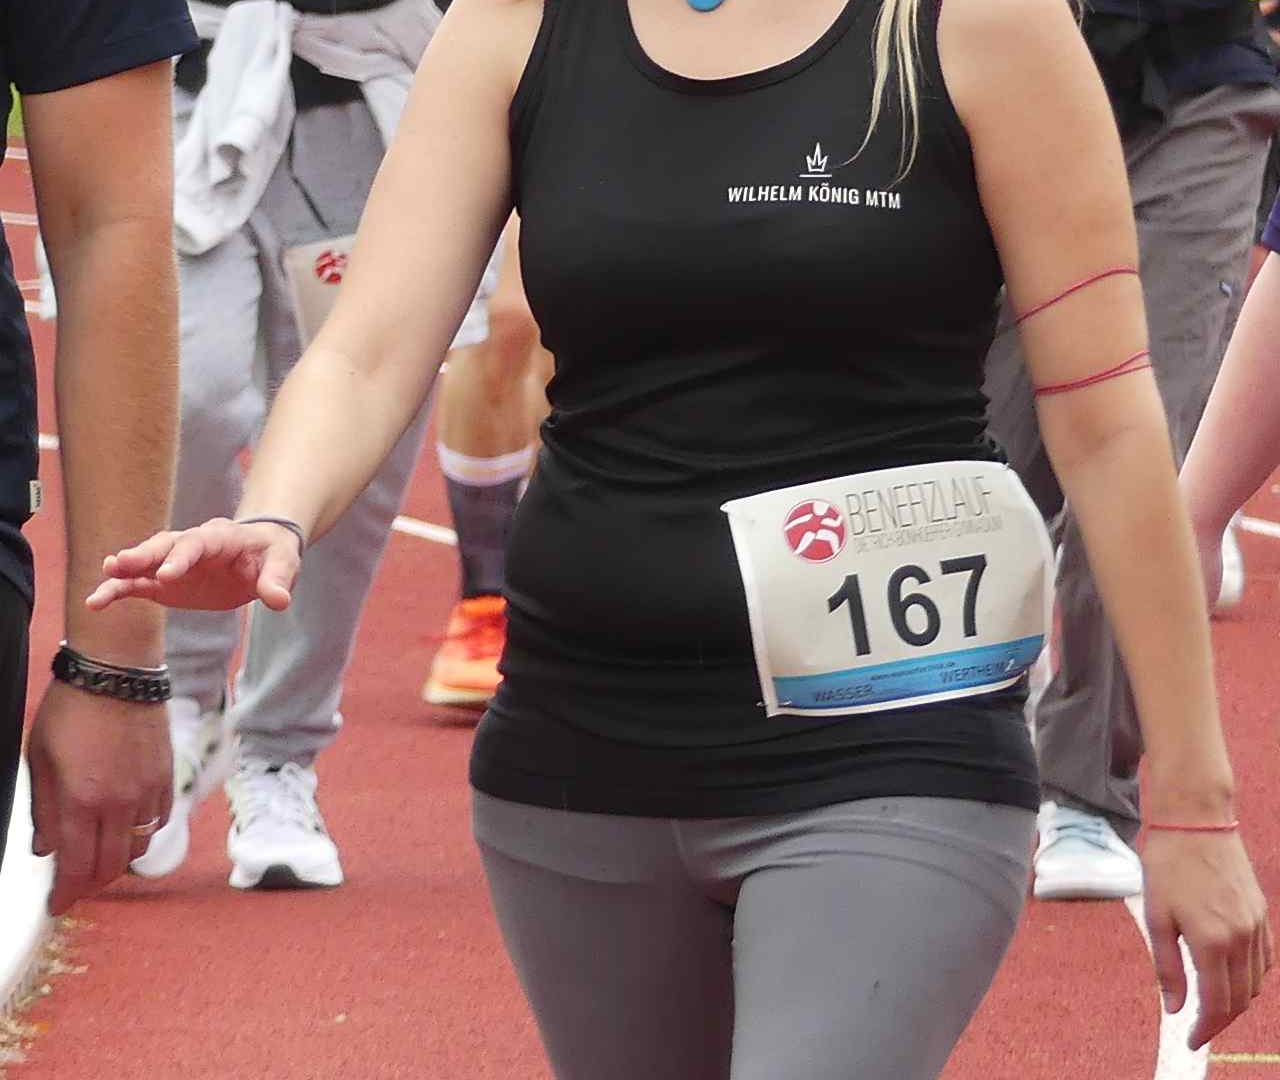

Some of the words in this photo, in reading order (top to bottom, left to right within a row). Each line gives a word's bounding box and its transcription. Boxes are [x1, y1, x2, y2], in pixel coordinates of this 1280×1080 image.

[728, 185, 802, 203] WILHELM
[808, 182, 860, 206] KÖNIG
[865, 190, 901, 209] MTM
[845, 475, 993, 537] BENEFIZLAUF
[827, 554, 987, 657] 167
